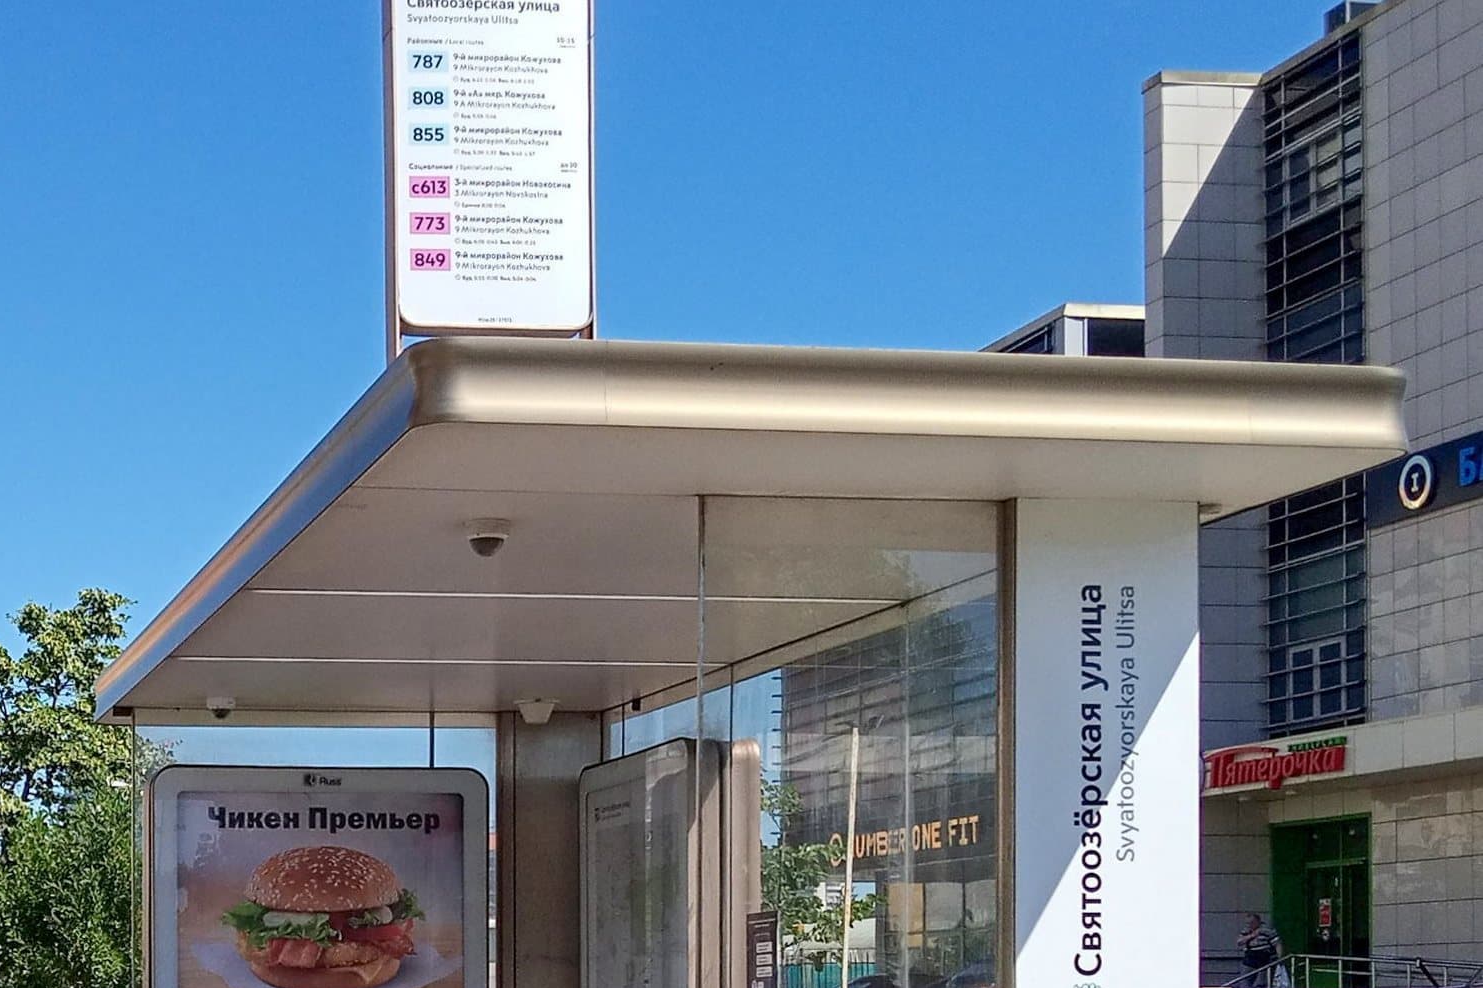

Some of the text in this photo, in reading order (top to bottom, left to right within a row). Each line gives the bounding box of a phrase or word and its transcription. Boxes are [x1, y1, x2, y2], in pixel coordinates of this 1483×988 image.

[518, 1, 560, 13] улица
[407, 13, 519, 25] Svyatoozyorskaya Ulitsa
[413, 55, 443, 69] 787
[413, 91, 444, 105] 808
[413, 128, 445, 141] 855
[414, 216, 445, 231] 773
[414, 253, 446, 267] 849
[1460, 444, 1483, 488] Б
[1080, 584, 1108, 692] улица
[1116, 585, 1139, 862] Svyatoozyorskaya Ulitsa
[208, 806, 440, 834] Чикен Премьер
[911, 821, 942, 851] ONE
[948, 815, 979, 847] FIT
[1074, 702, 1108, 976] Святоозёрская
